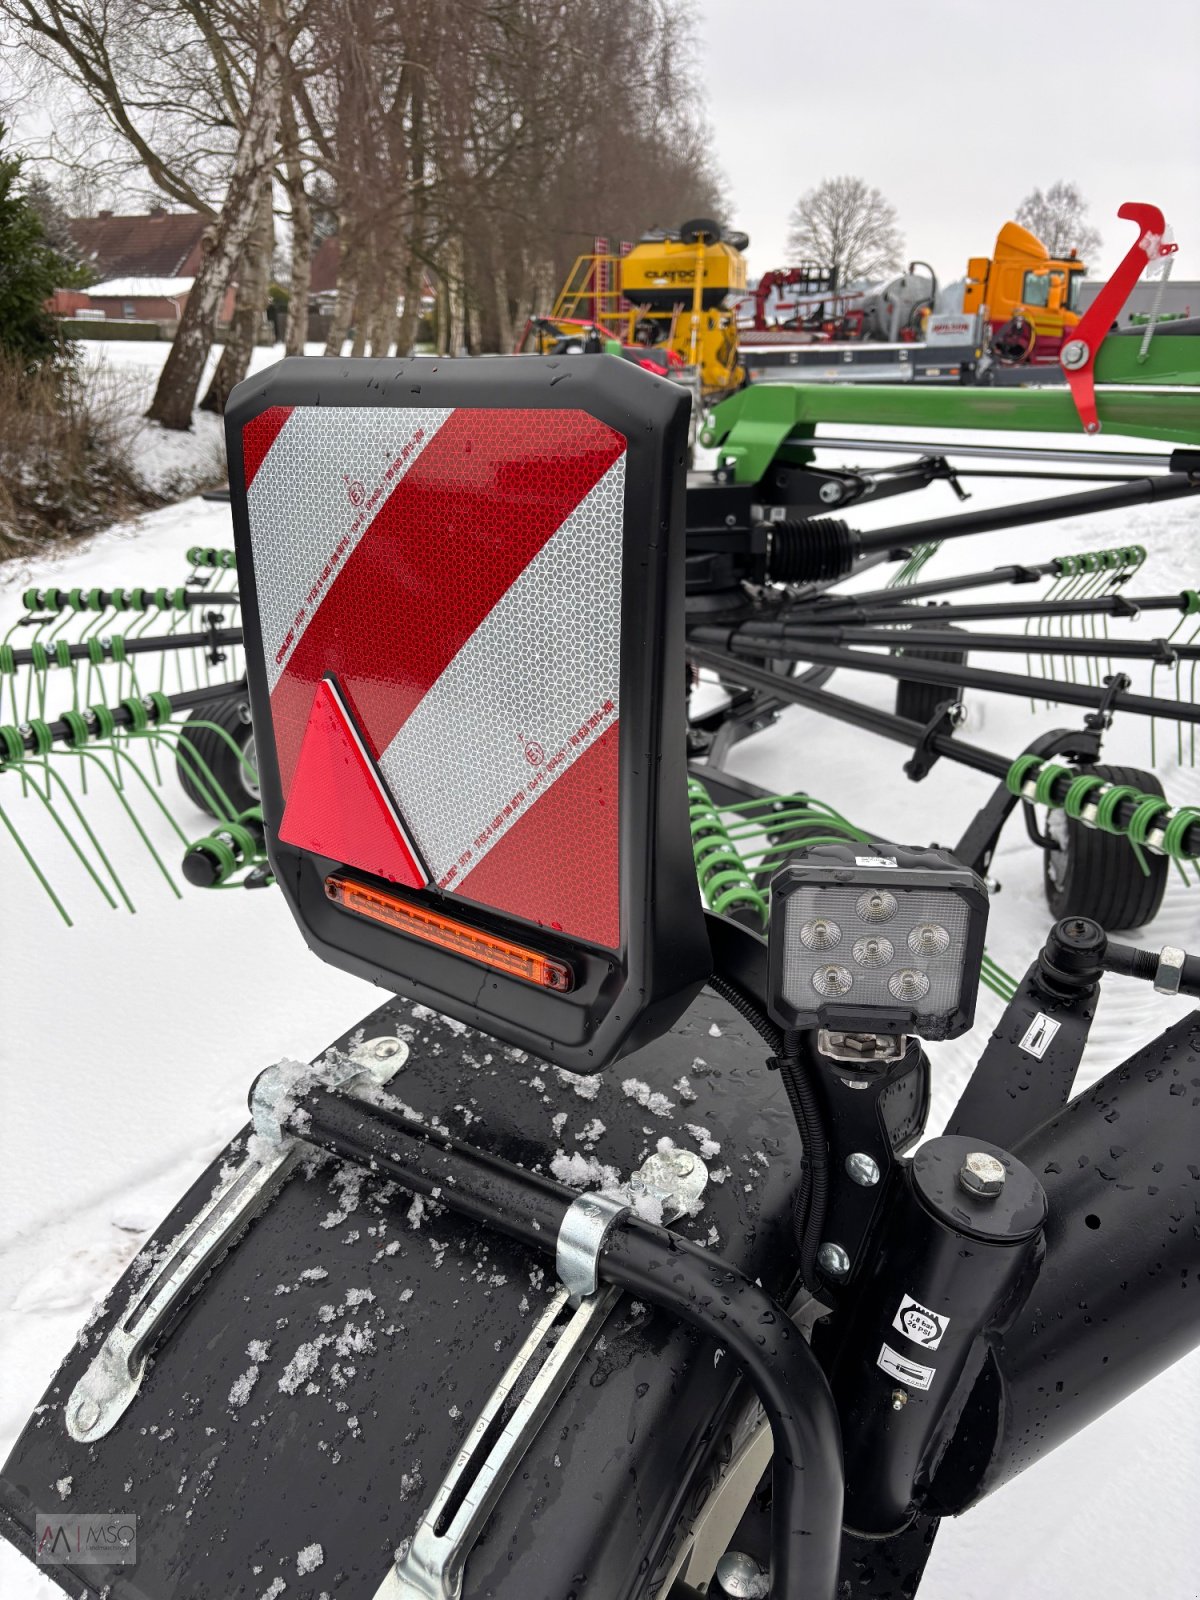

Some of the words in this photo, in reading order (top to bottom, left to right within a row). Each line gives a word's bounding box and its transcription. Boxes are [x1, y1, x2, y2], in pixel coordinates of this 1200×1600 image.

[644, 270, 708, 283] CLAYDO
[907, 1319, 917, 1330] 26
[917, 1325, 932, 1337] PSI
[921, 1319, 935, 1331] bar
